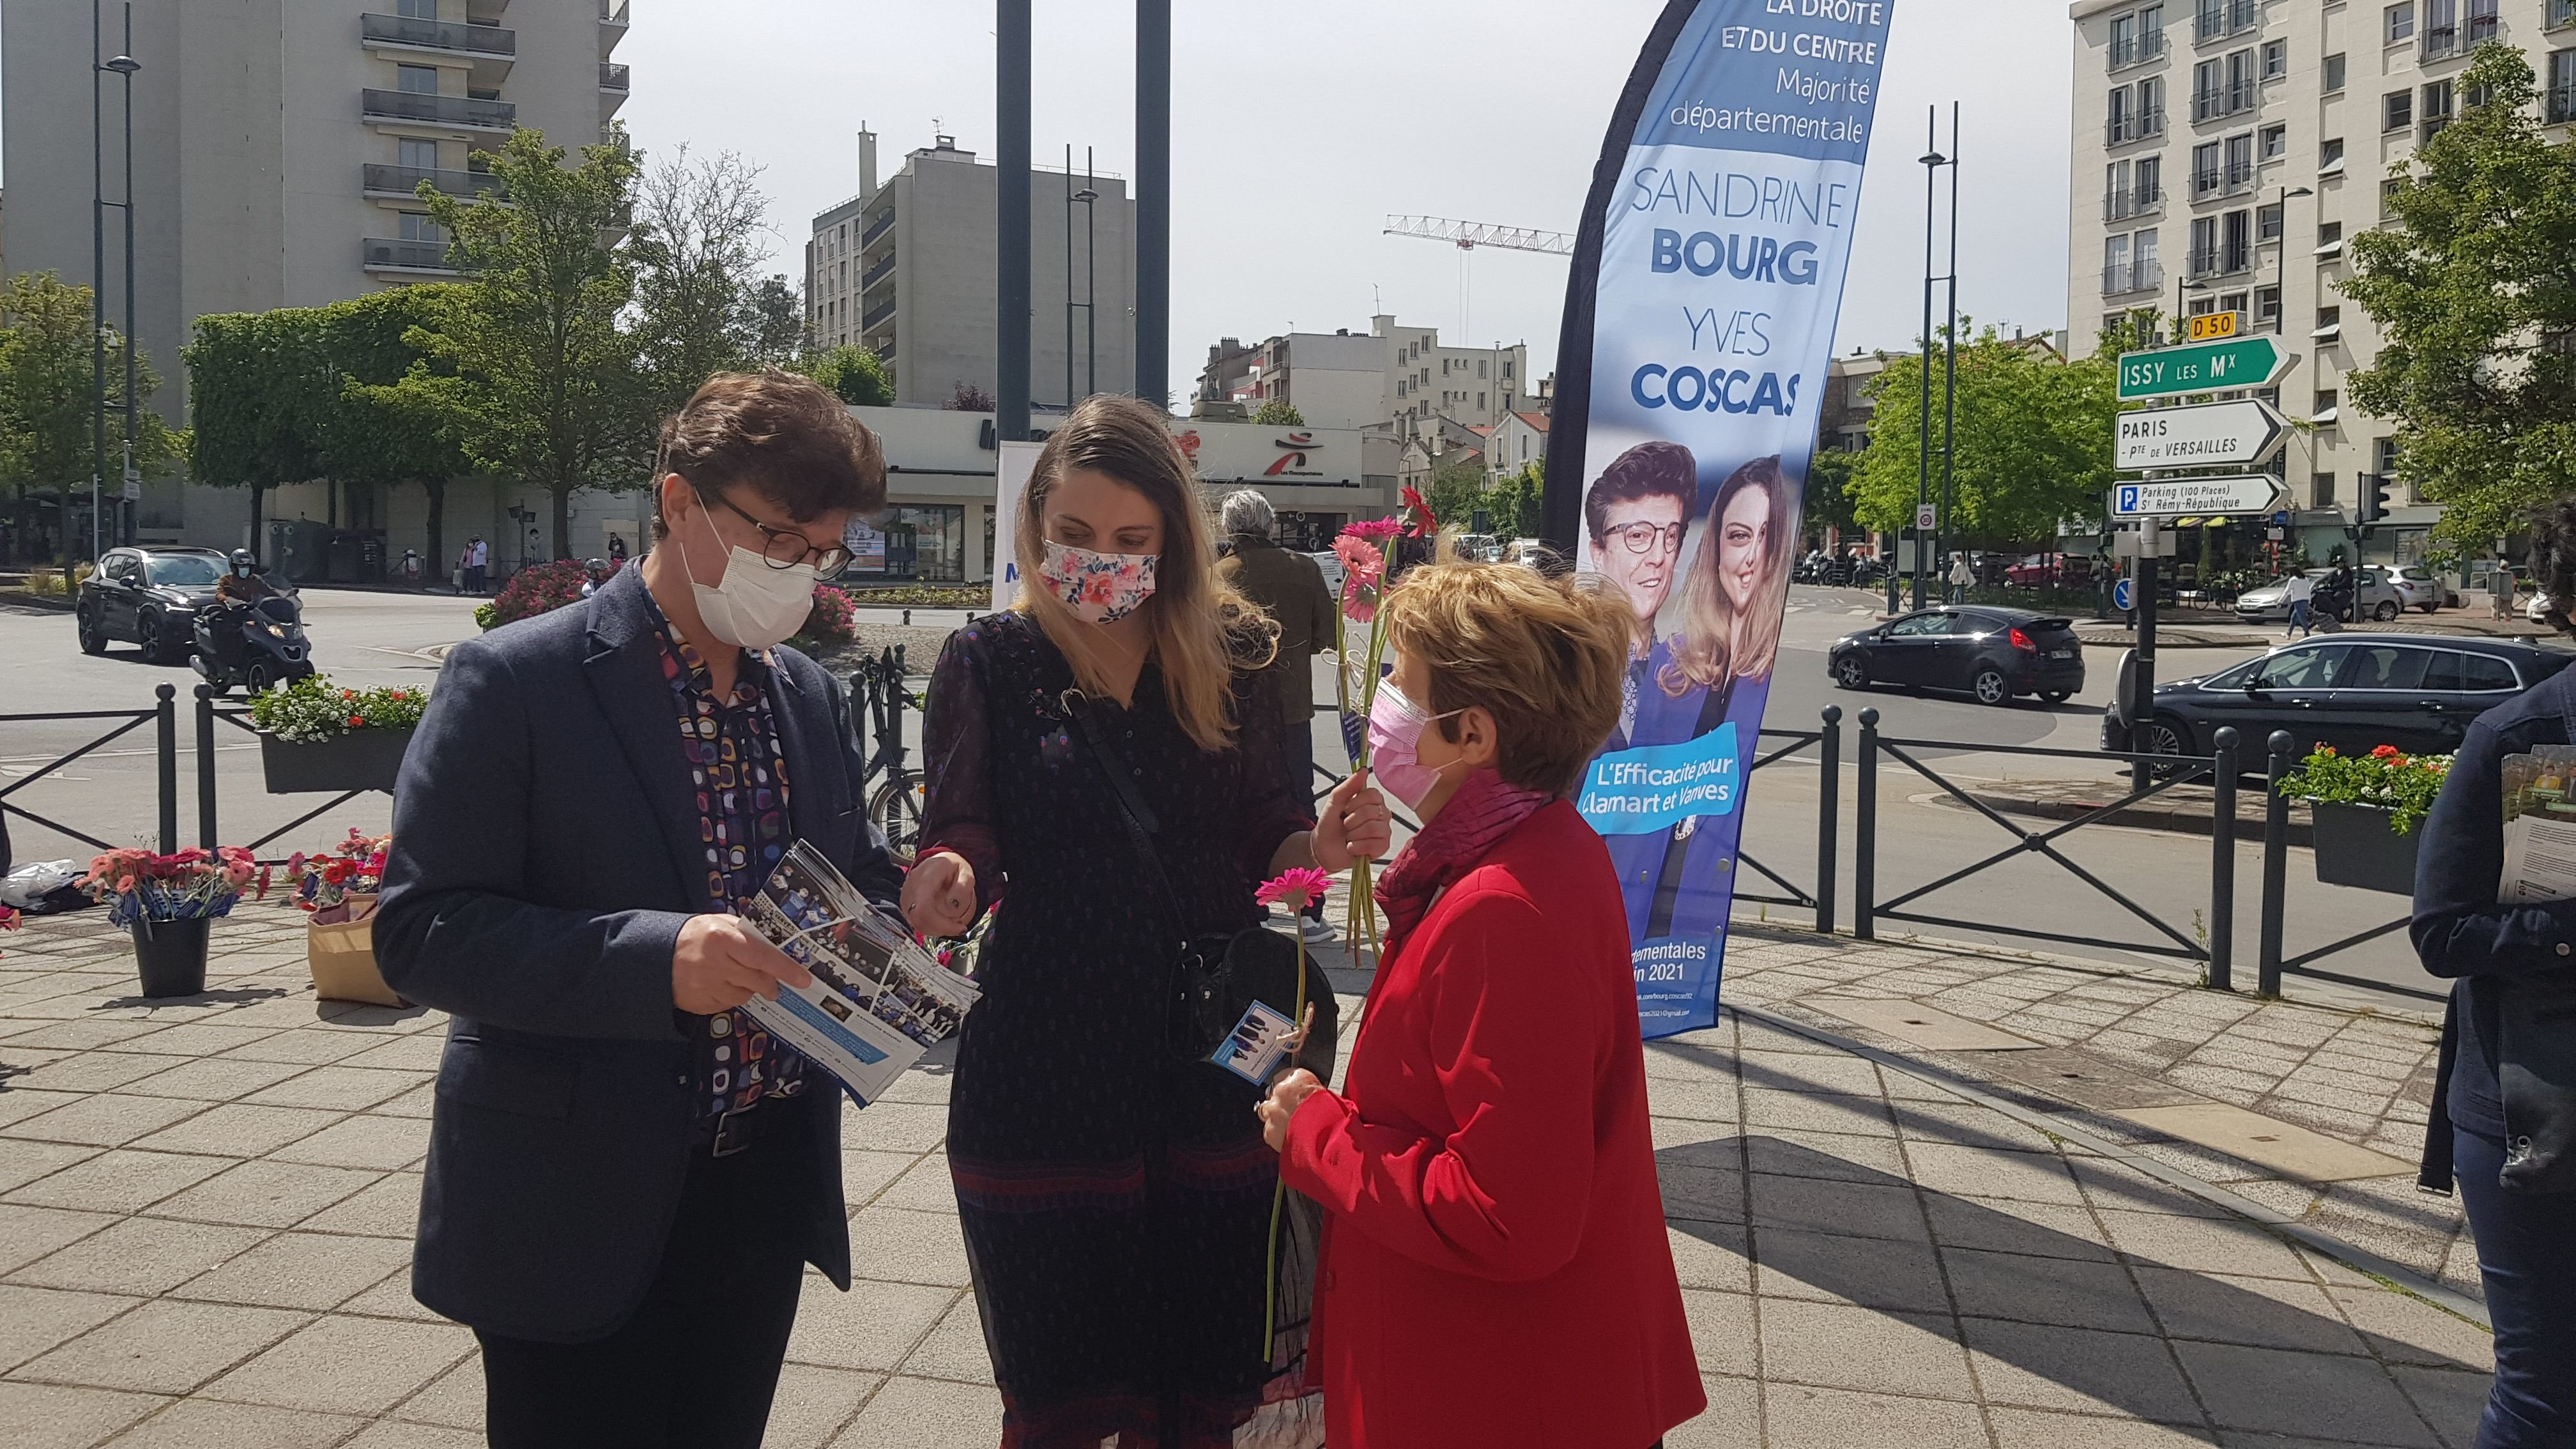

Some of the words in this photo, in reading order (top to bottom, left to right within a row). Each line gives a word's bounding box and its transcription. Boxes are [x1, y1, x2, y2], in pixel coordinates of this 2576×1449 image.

[1766, 0, 1795, 15] LA
[1802, 0, 1882, 26] DROITE
[1793, 33, 1877, 65] CENTRE
[1776, 68, 1870, 105] Majorité
[1670, 100, 1863, 144] départementale
[1632, 167, 1846, 228] SANDRINE
[1651, 228, 1818, 286] BOURG
[1683, 307, 1772, 356] YVES
[2194, 321, 2203, 337] D
[2209, 317, 2230, 334] 50
[2124, 362, 2165, 387] ISSY
[2177, 365, 2198, 381] LES
[1631, 364, 1800, 417] COSCAS
[2122, 420, 2168, 439] PARIS
[2166, 438, 2237, 456] VERSAILLES
[2142, 486, 2177, 499] Parking
[2181, 487, 2198, 498] (100
[2201, 484, 2230, 496] Places)
[2156, 497, 2240, 512] Rémy-République
[1597, 760, 1697, 786] L'Efficacité
[1696, 758, 1733, 783] pour
[1662, 792, 1678, 811] et
[1679, 784, 1729, 807] Vanves
[1648, 963, 1683, 981] 2021
